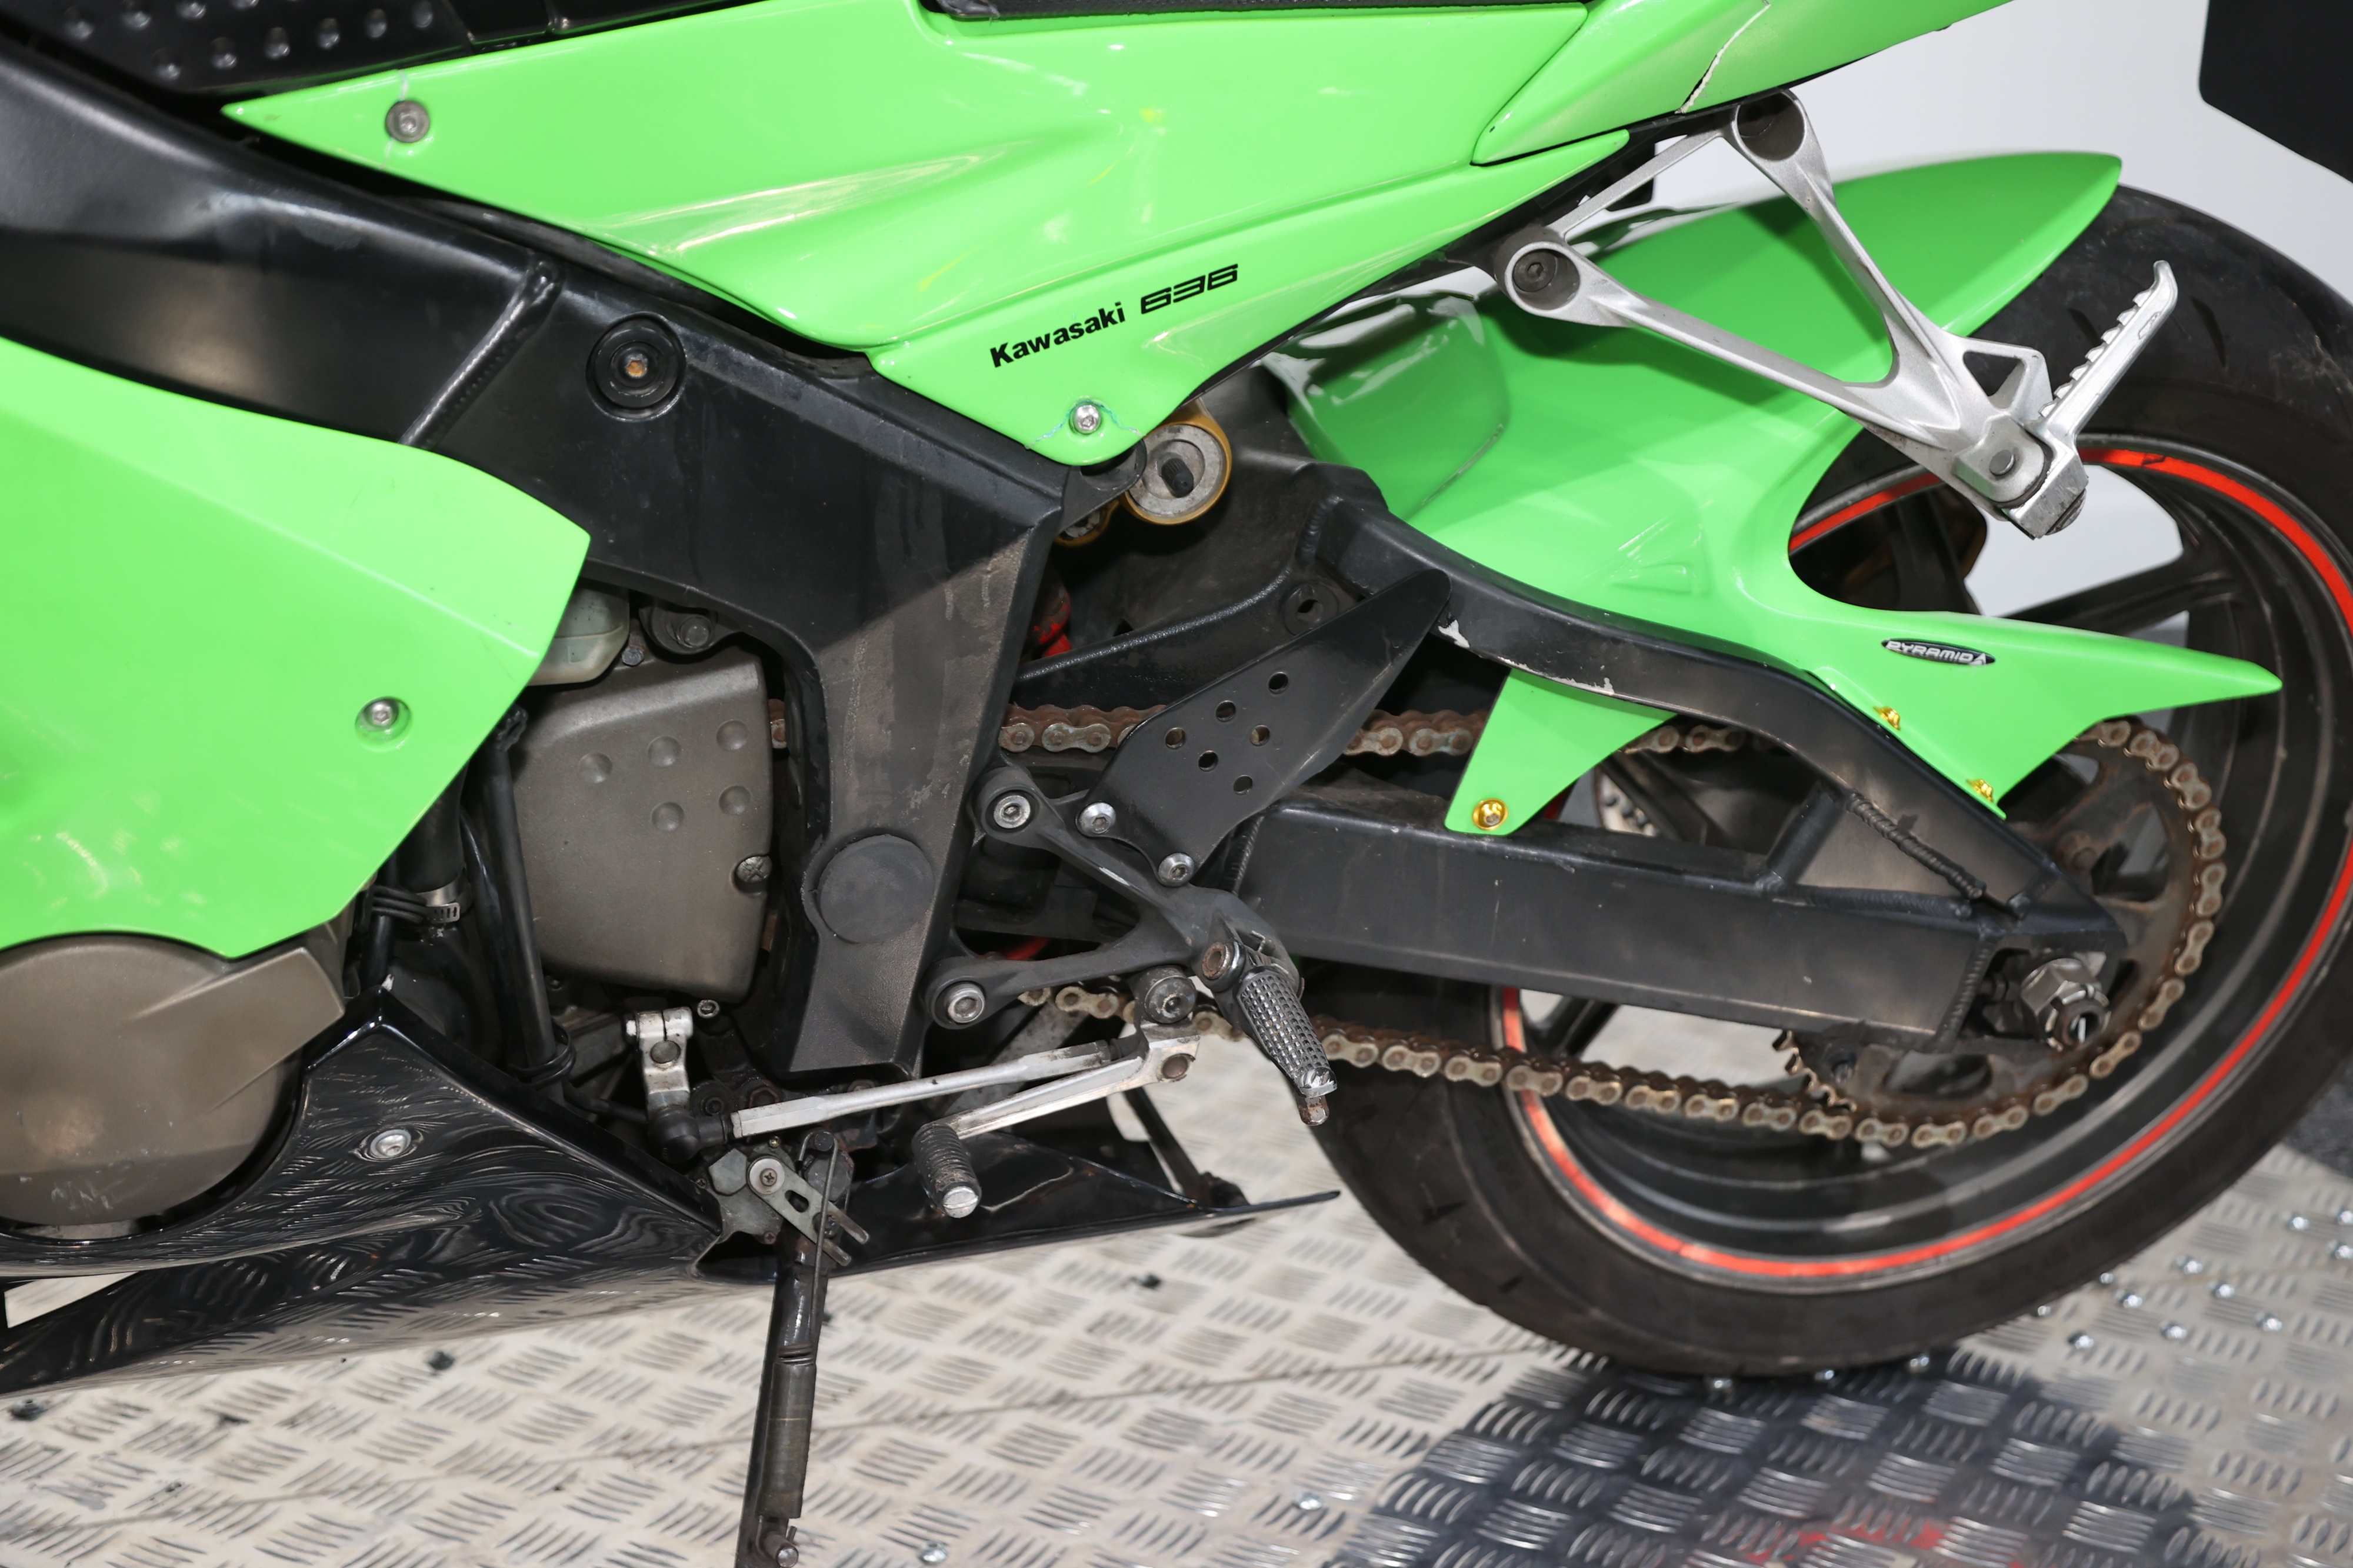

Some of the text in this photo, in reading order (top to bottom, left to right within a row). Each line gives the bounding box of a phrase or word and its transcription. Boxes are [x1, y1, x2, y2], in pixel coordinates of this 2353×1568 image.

[989, 263, 1239, 368] Kawasaki 636
[1885, 640, 1974, 663] PYRAMID
